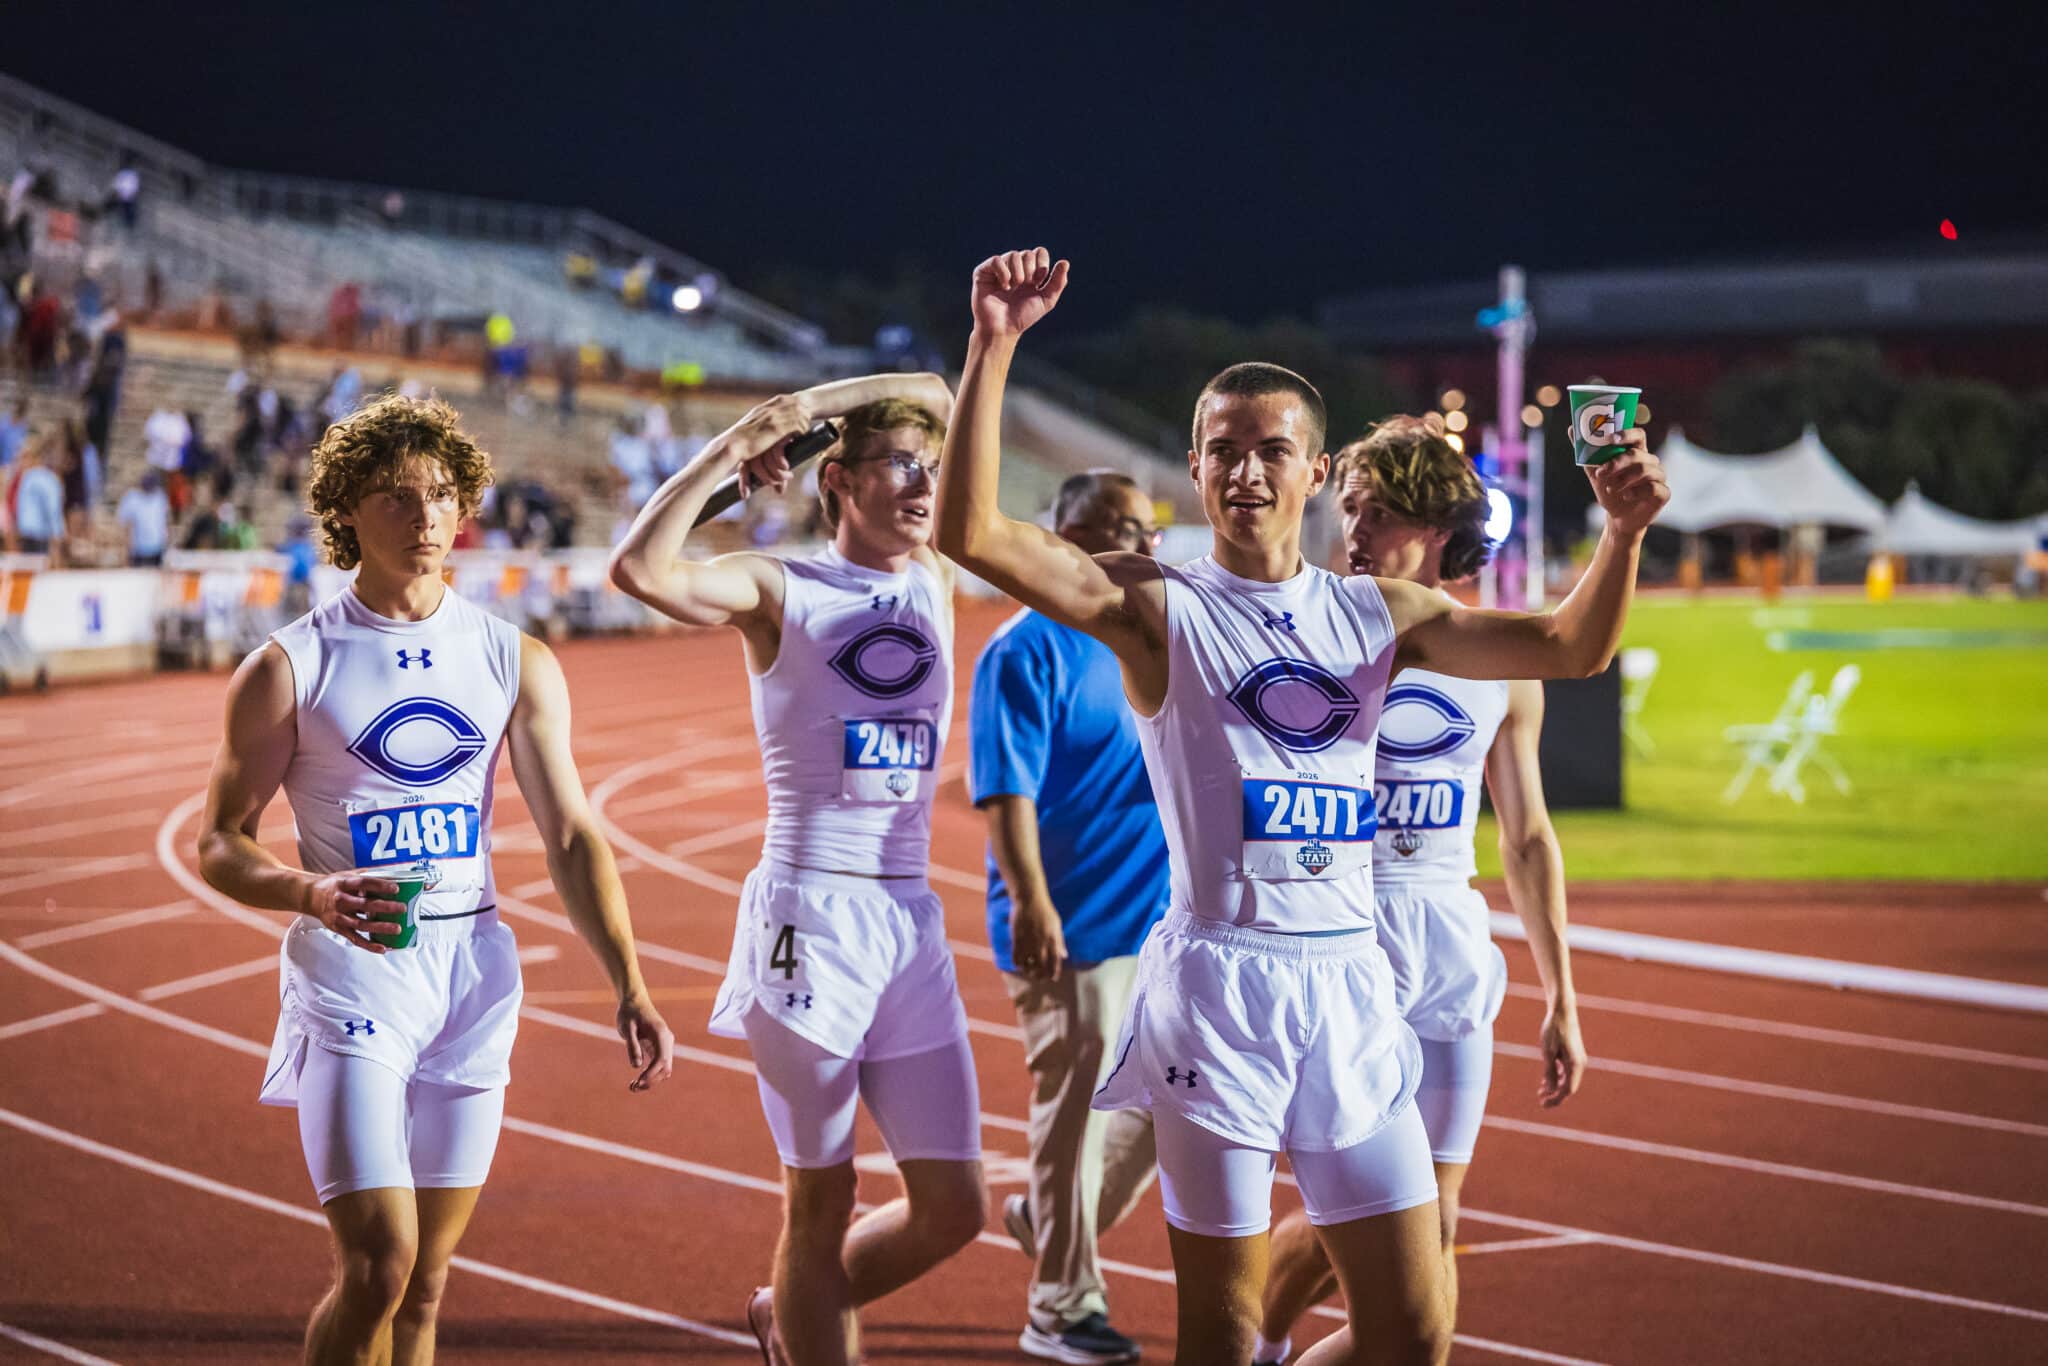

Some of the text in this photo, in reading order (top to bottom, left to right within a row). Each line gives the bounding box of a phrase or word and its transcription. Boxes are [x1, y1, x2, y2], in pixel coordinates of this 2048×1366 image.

[1580, 404, 1615, 446] G
[828, 623, 937, 700] C
[1226, 657, 1360, 754] C
[346, 696, 487, 787] C
[858, 722, 930, 766] 2479
[1264, 784, 1358, 836] 2477
[1374, 783, 1453, 825] 2470
[366, 807, 468, 861] 2481
[1297, 853, 1333, 863] STATE
[770, 924, 798, 980] 4
